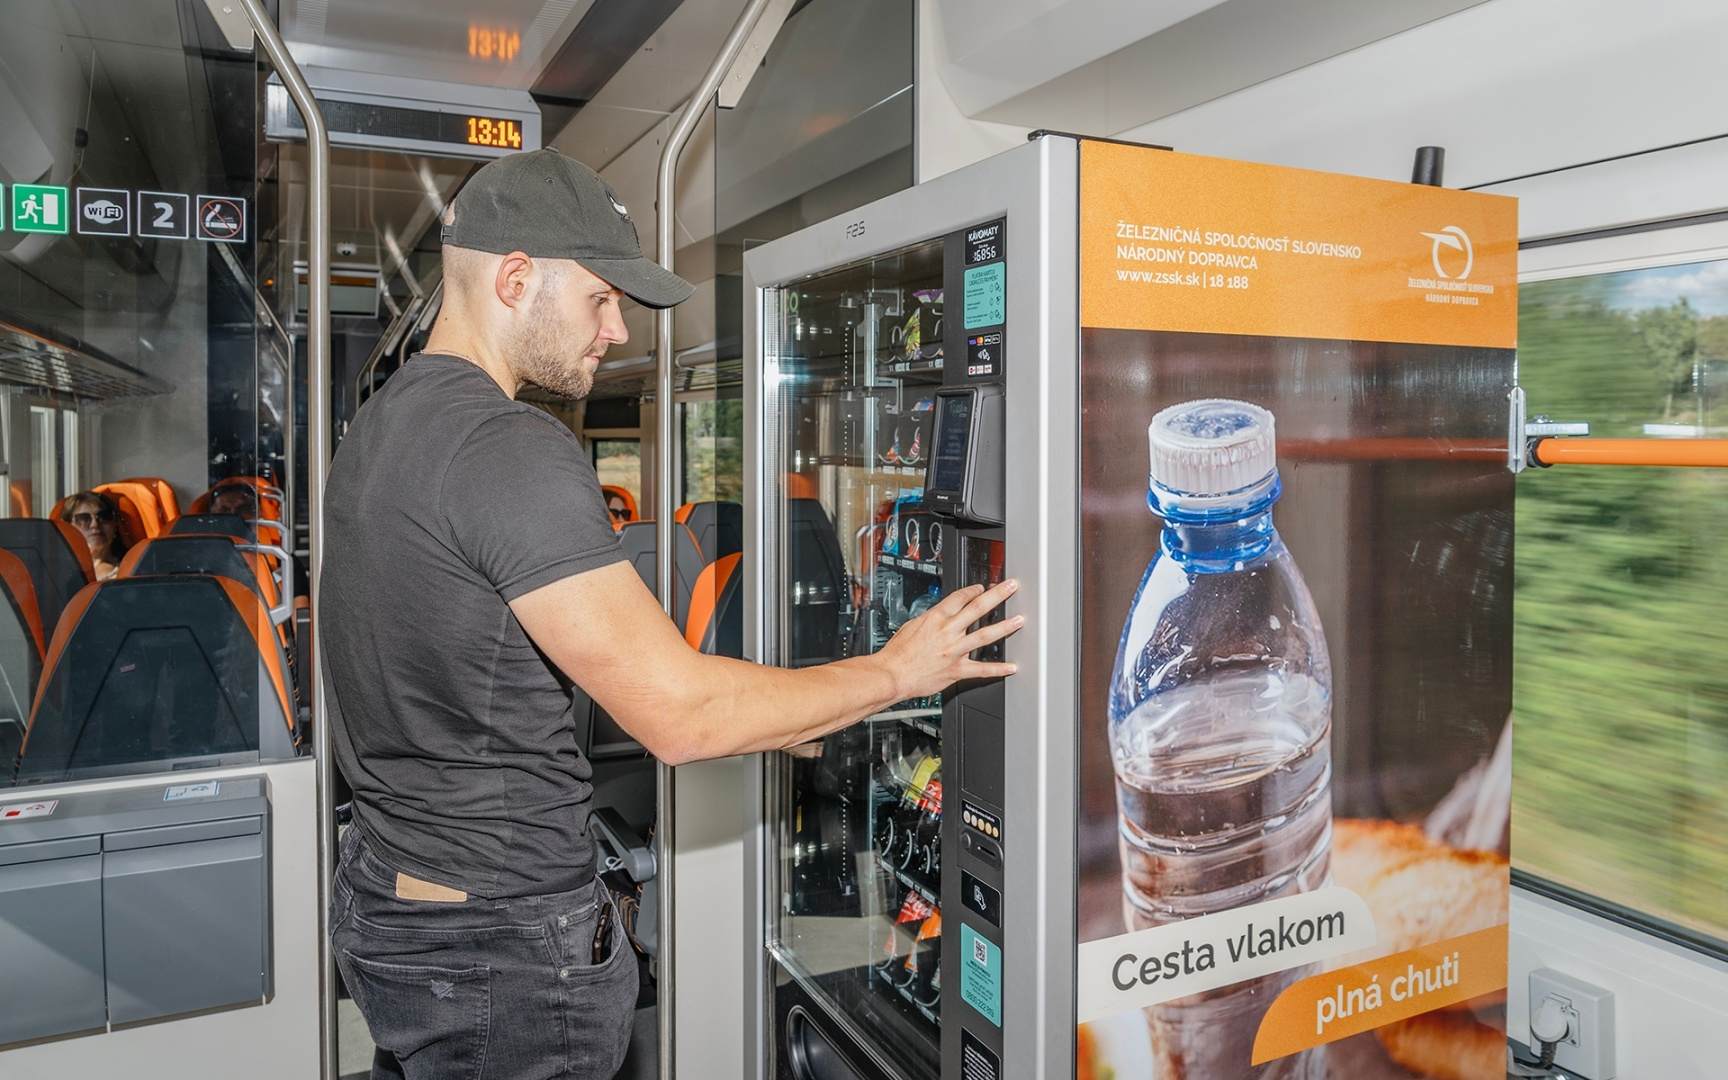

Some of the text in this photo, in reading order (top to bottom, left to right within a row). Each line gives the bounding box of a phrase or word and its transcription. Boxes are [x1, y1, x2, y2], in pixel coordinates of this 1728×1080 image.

[468, 117, 521, 148] 13:14
[153, 202, 174, 228] 2
[1116, 219, 1362, 259] ŽELEZNIČNÁ SPOLOČNOSŤ SLOVENSKO
[1116, 242, 1258, 270] NÁRODNÝ DOPRAVCA
[1116, 269, 1200, 286] www.zssk.sk
[1209, 274, 1224, 288] 18
[1227, 275, 1249, 289] 188
[1111, 910, 1345, 991] Cesta vlakom
[1316, 951, 1460, 1035] plná chuti
